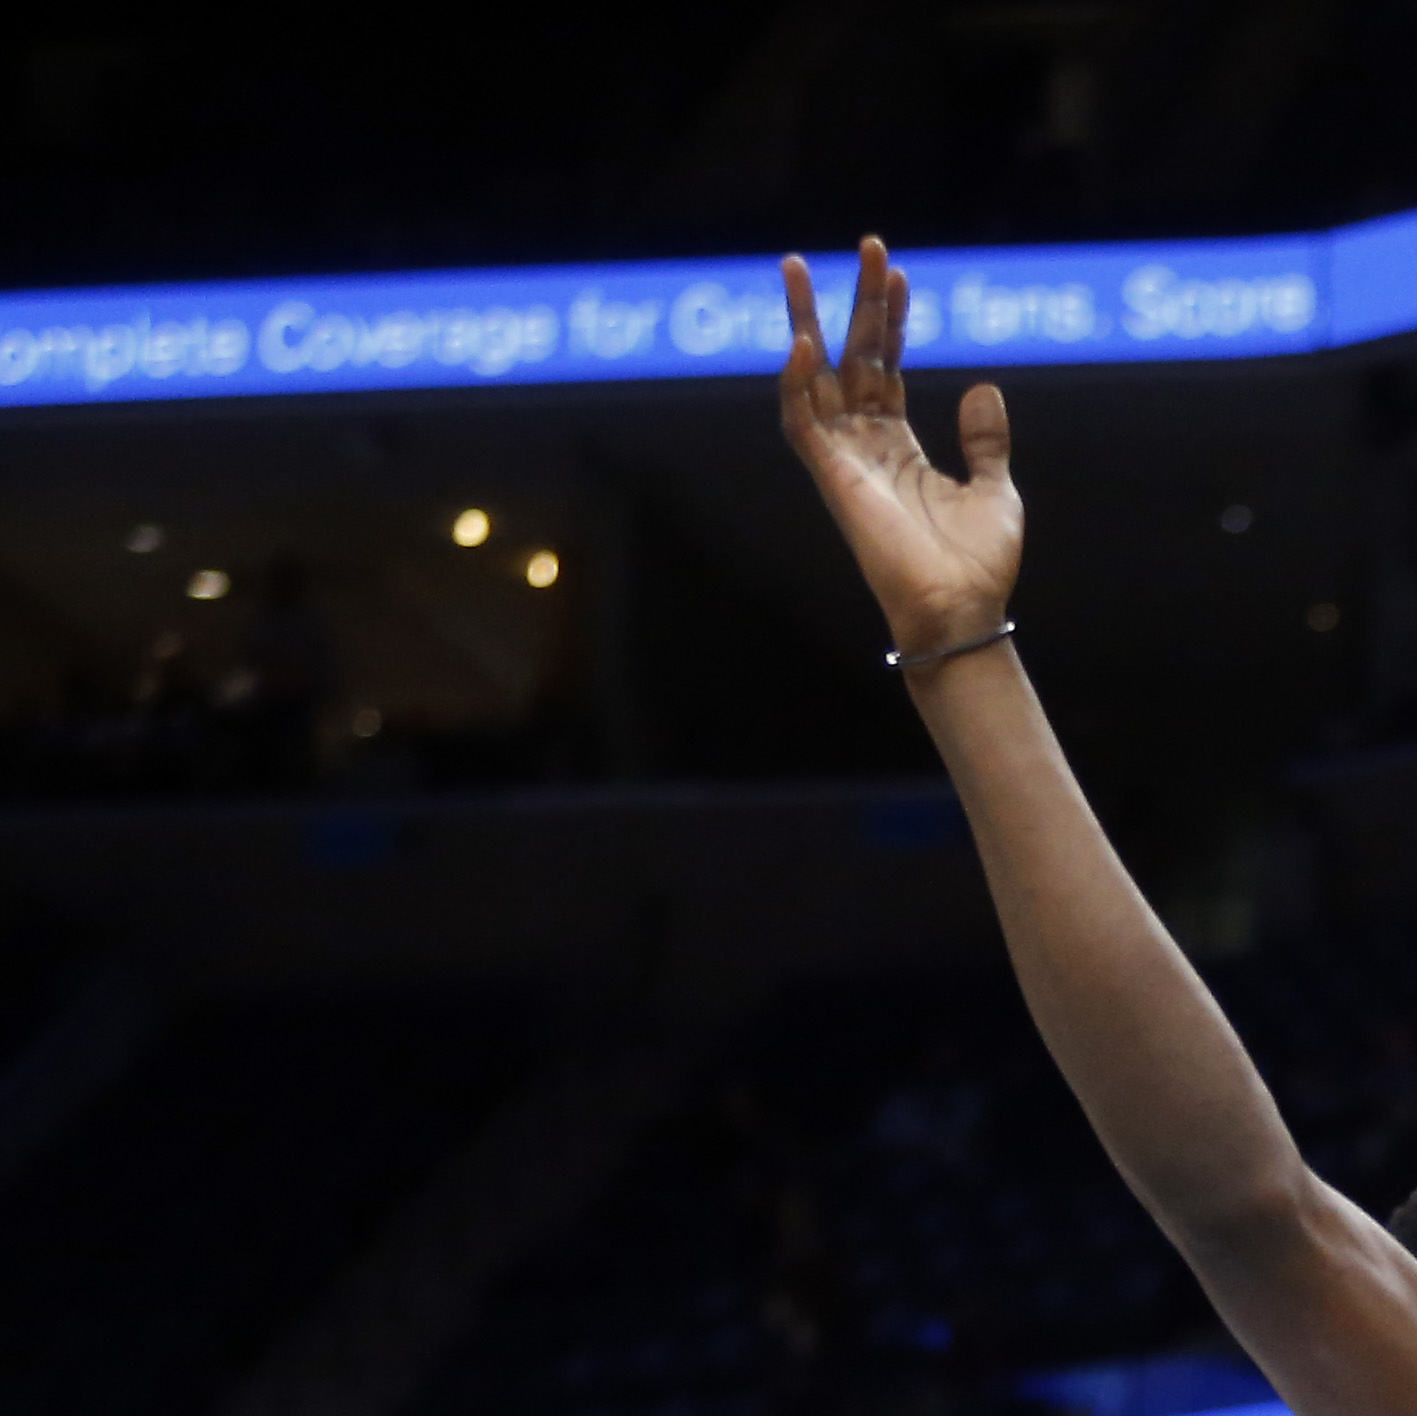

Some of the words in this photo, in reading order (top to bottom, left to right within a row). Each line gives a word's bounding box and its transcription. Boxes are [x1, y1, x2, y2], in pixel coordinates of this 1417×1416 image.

[259, 299, 560, 377] Coverage
[569, 287, 662, 359] for
[1120, 263, 1317, 340] Score
